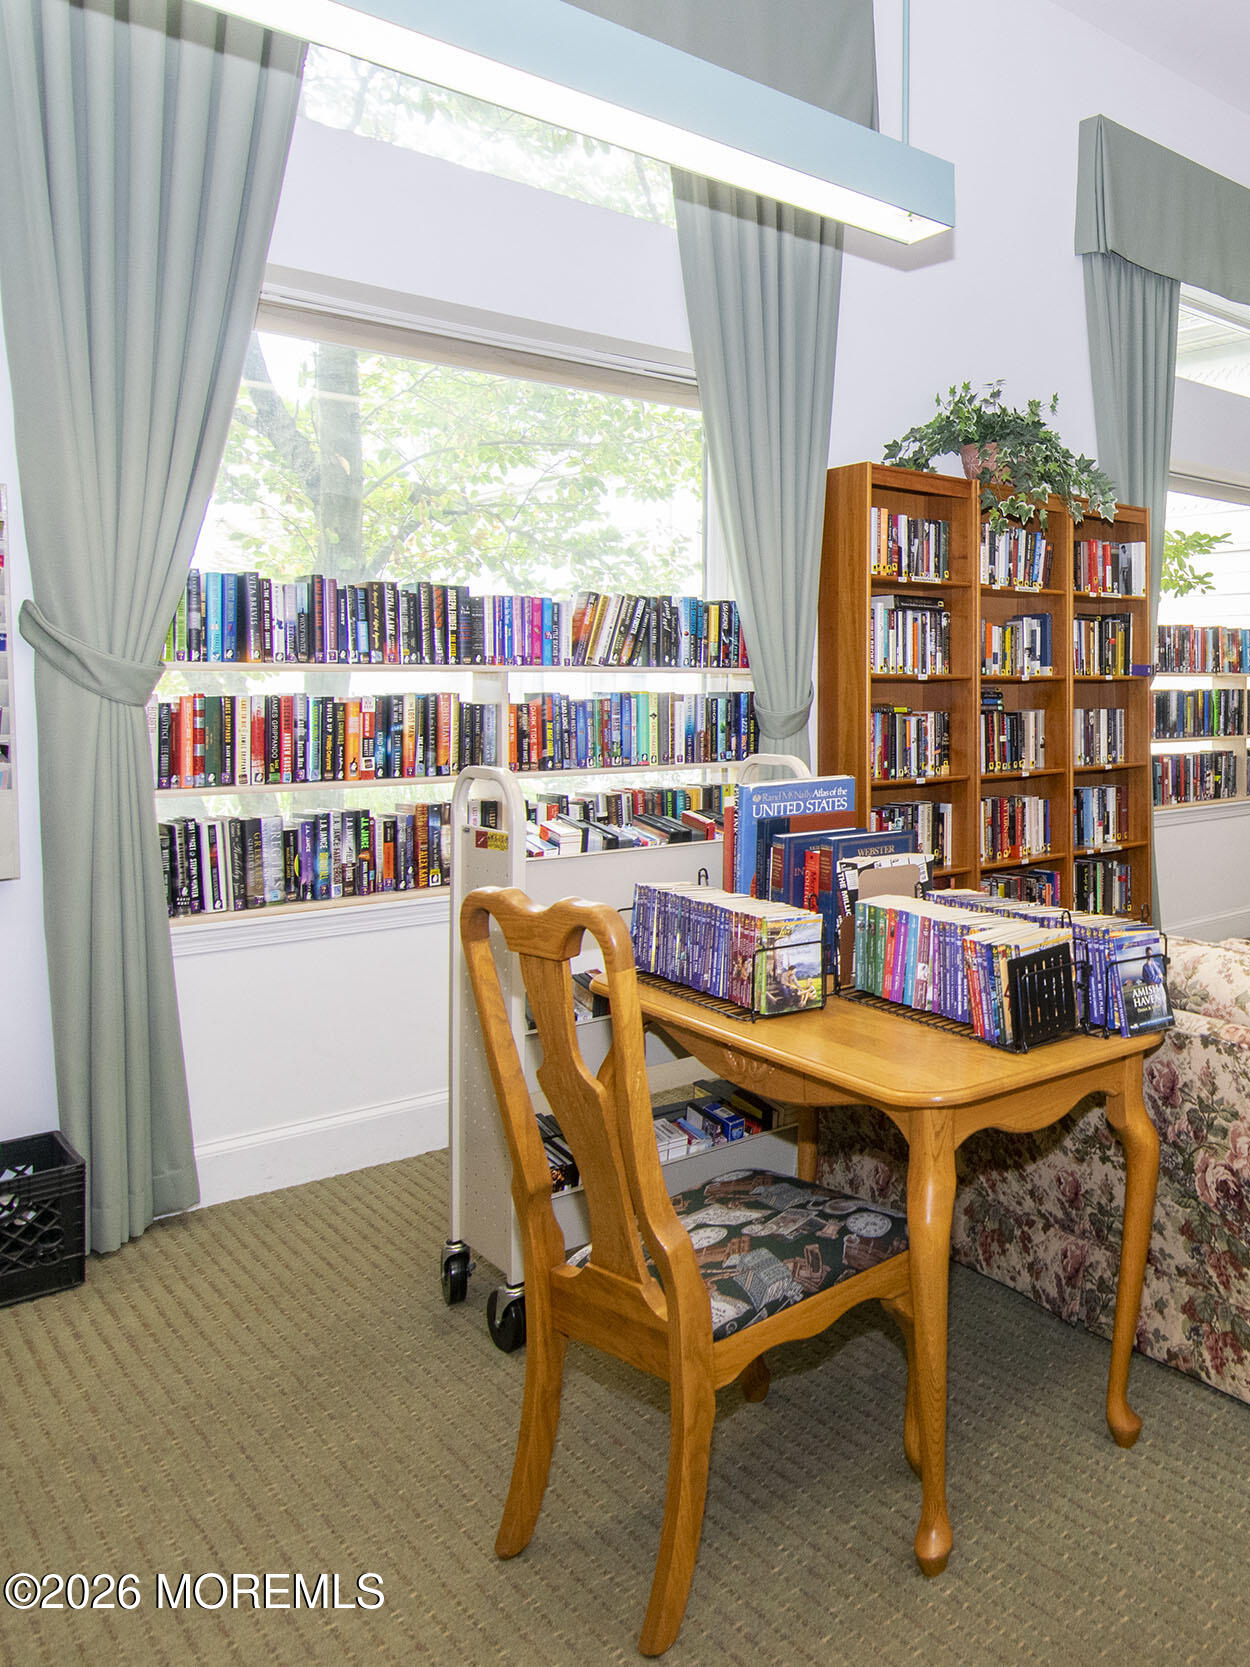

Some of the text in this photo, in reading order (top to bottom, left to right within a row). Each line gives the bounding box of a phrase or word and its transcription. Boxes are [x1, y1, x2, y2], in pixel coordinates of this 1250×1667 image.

[249, 575, 258, 625] VITA BREVIS
[387, 590, 396, 635] FATAL FLAME
[271, 696, 280, 759] JAMES GRIPPANDO
[761, 791, 782, 802] Rand
[813, 788, 829, 798] Atlas
[752, 797, 848, 818] UNITED STATES
[857, 845, 896, 857] WEBSTER
[803, 870, 811, 906] COLLEGE
[837, 871, 848, 889] THE
[1132, 984, 1160, 999] AMISH
